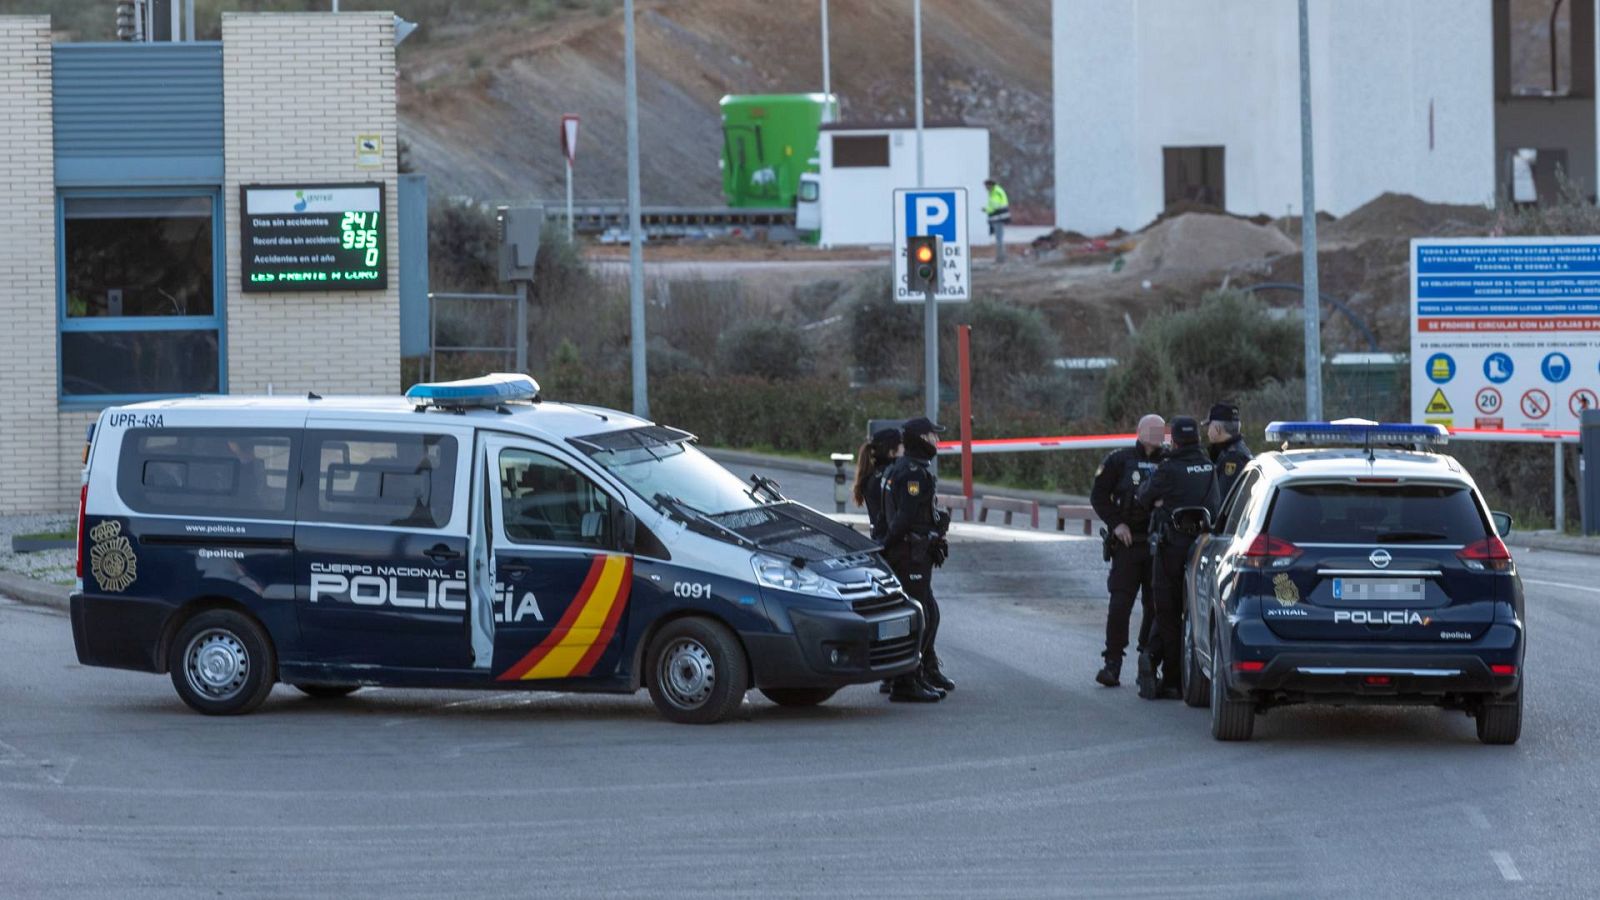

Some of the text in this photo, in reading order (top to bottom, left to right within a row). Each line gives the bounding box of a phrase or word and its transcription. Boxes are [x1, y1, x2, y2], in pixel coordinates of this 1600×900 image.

[273, 218, 284, 226] sin
[286, 217, 328, 226] accidentes
[341, 212, 377, 230] 241
[916, 197, 949, 237] P
[253, 237, 276, 245] Record
[294, 236, 304, 244] sin
[305, 235, 340, 244] accidentes
[343, 230, 377, 249] 935
[945, 246, 961, 256] DE
[254, 255, 297, 263] Accidentes
[312, 254, 319, 262] el
[321, 254, 335, 262] año
[365, 248, 378, 266] 0
[954, 273, 960, 282] Y
[1478, 321, 1518, 329] CIRCULAR
[1481, 395, 1497, 407] 20
[110, 414, 164, 428] UPR-43A
[186, 524, 246, 534] www.policia.es
[198, 548, 244, 559] @policia
[310, 563, 372, 575] CUERPO
[377, 567, 450, 579] NACIONAL
[1334, 608, 1424, 625] POLICÍA
